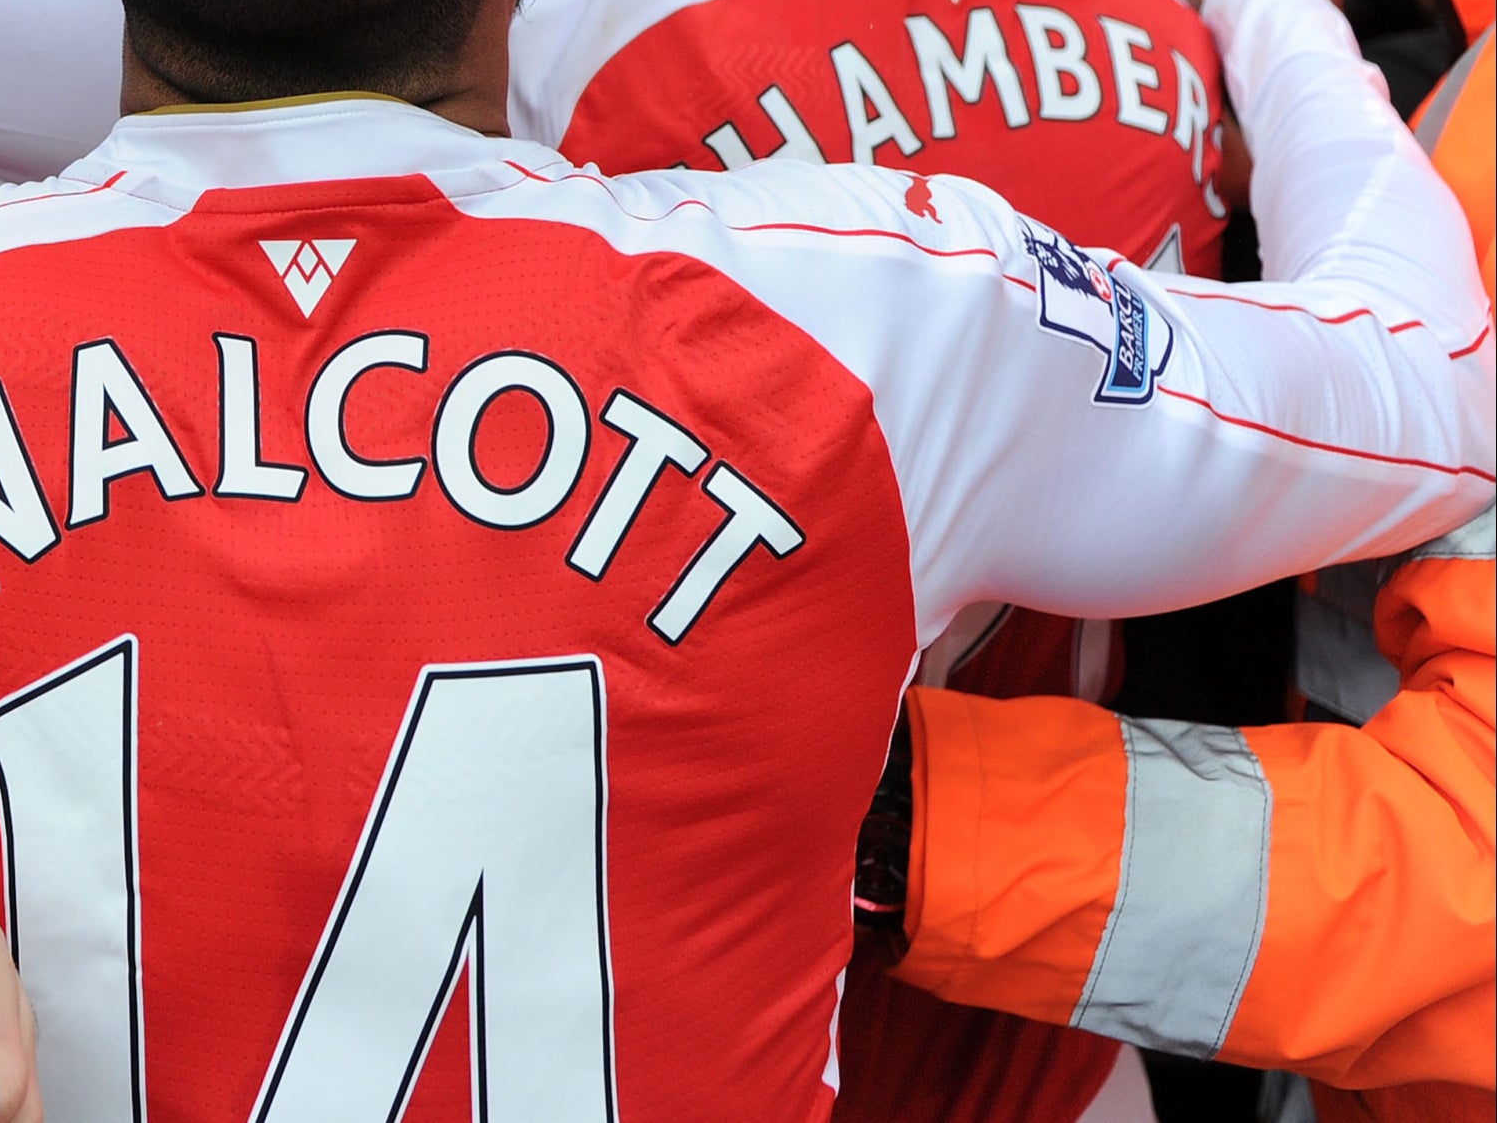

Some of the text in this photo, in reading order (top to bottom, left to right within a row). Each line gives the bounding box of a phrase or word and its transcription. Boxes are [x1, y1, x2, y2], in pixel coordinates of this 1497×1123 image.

[668, 3, 1228, 219] HAMBER
[1115, 284, 1135, 372] BARCL
[1132, 310, 1144, 381] PREMIER
